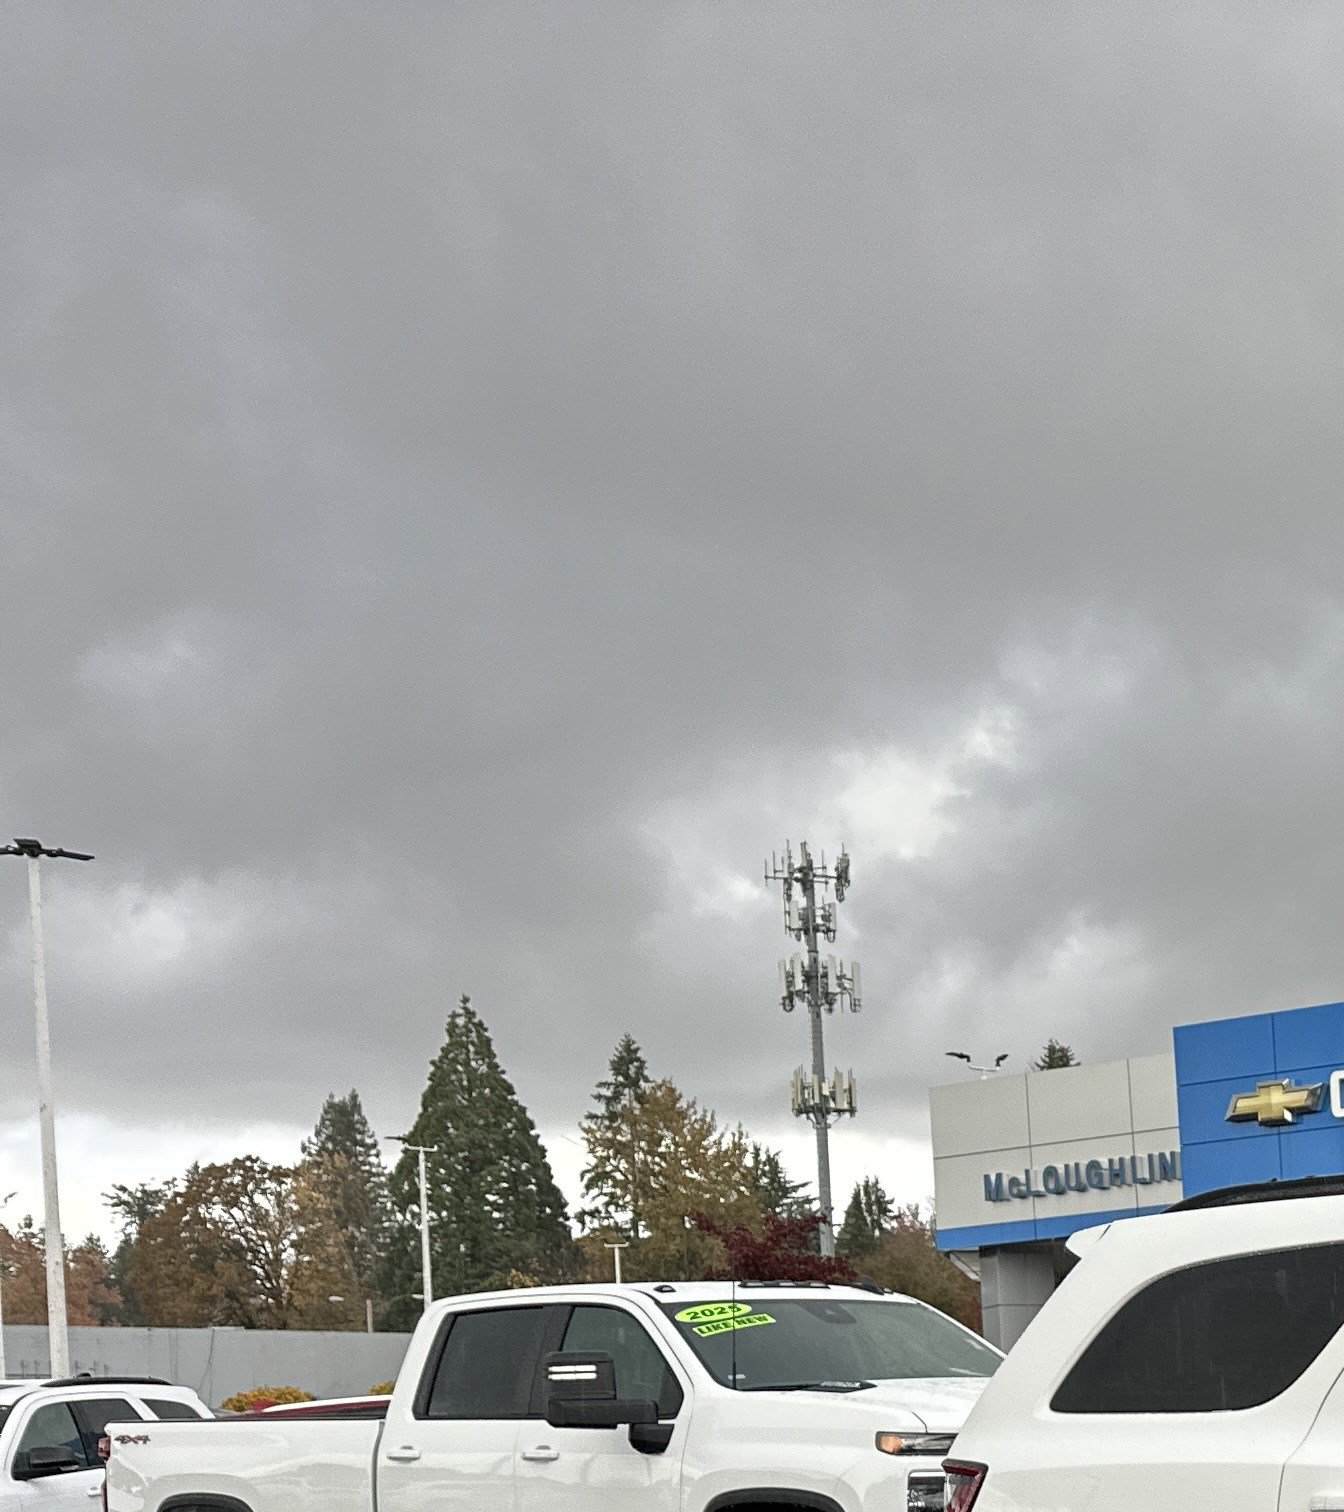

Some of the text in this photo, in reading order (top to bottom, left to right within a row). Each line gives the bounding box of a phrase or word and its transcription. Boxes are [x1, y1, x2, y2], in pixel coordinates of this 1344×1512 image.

[983, 1150, 1181, 1202] McLOUGHLIN
[697, 1315, 769, 1334] LIKE NEW
